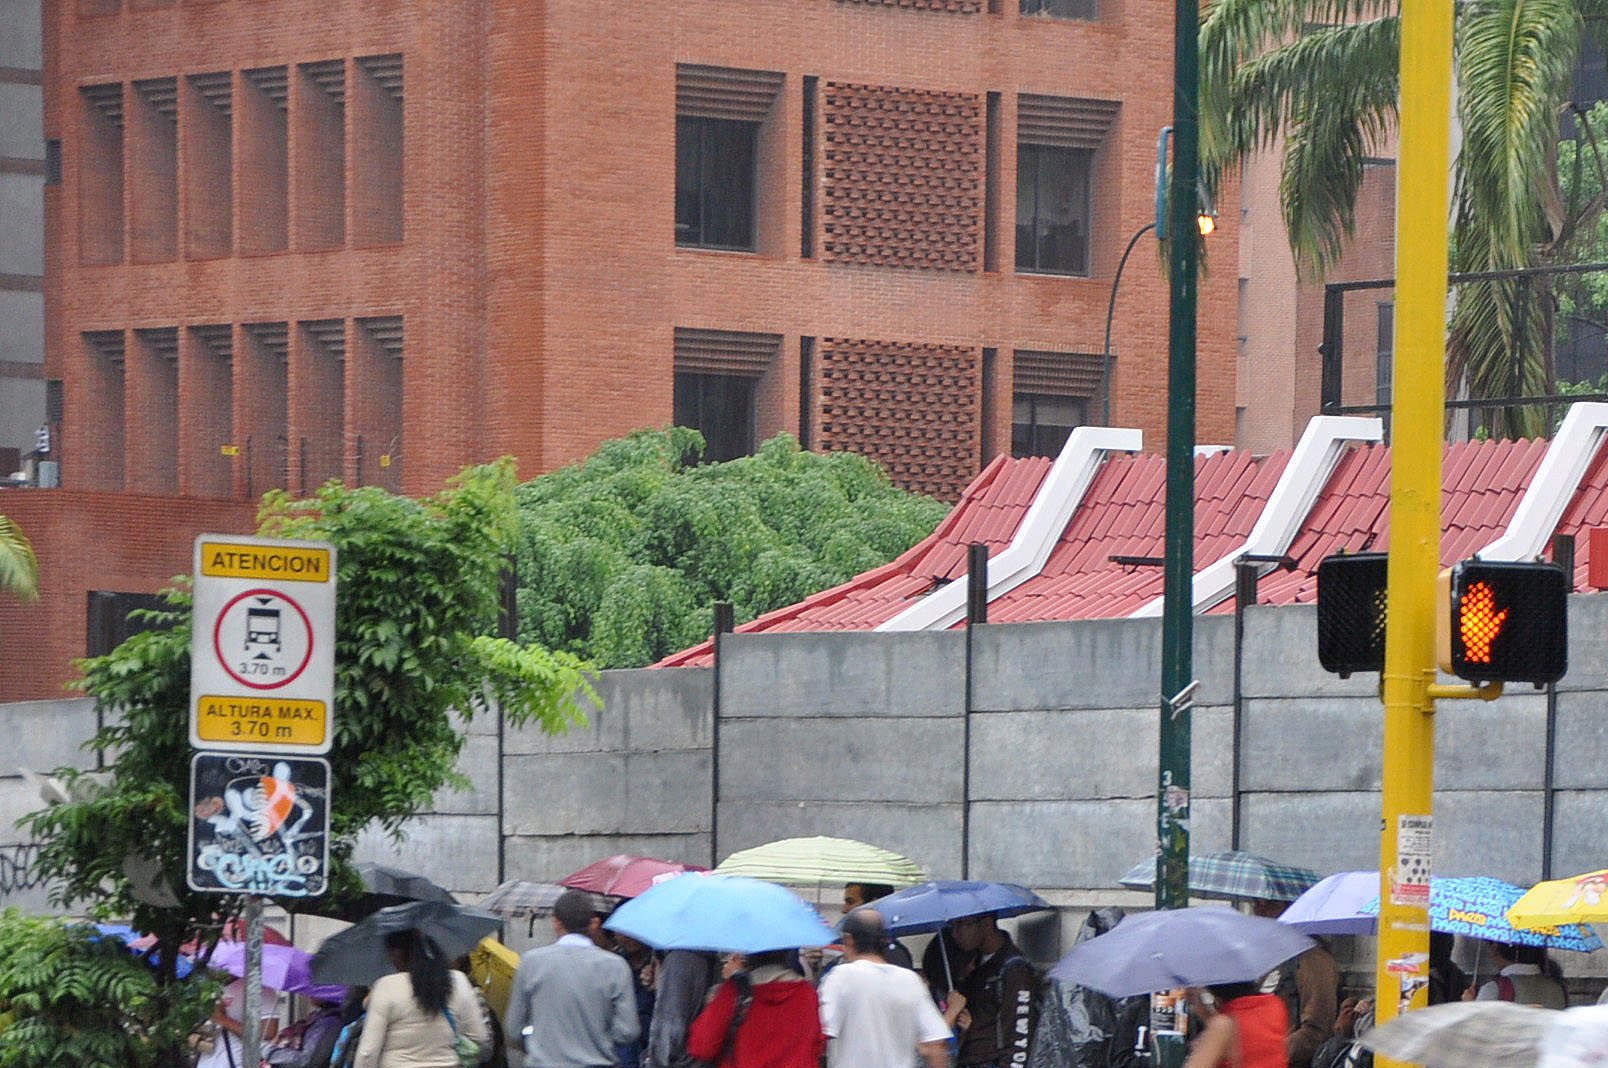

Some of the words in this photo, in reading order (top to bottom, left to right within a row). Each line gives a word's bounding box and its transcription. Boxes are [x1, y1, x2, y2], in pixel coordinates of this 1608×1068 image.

[211, 551, 321, 574] ATENCION
[239, 662, 269, 676] 3.70
[272, 666, 286, 676] m
[207, 704, 272, 719] ALTURA
[277, 706, 319, 721] MAX.
[230, 720, 270, 738] 3.70
[275, 725, 293, 738] m
